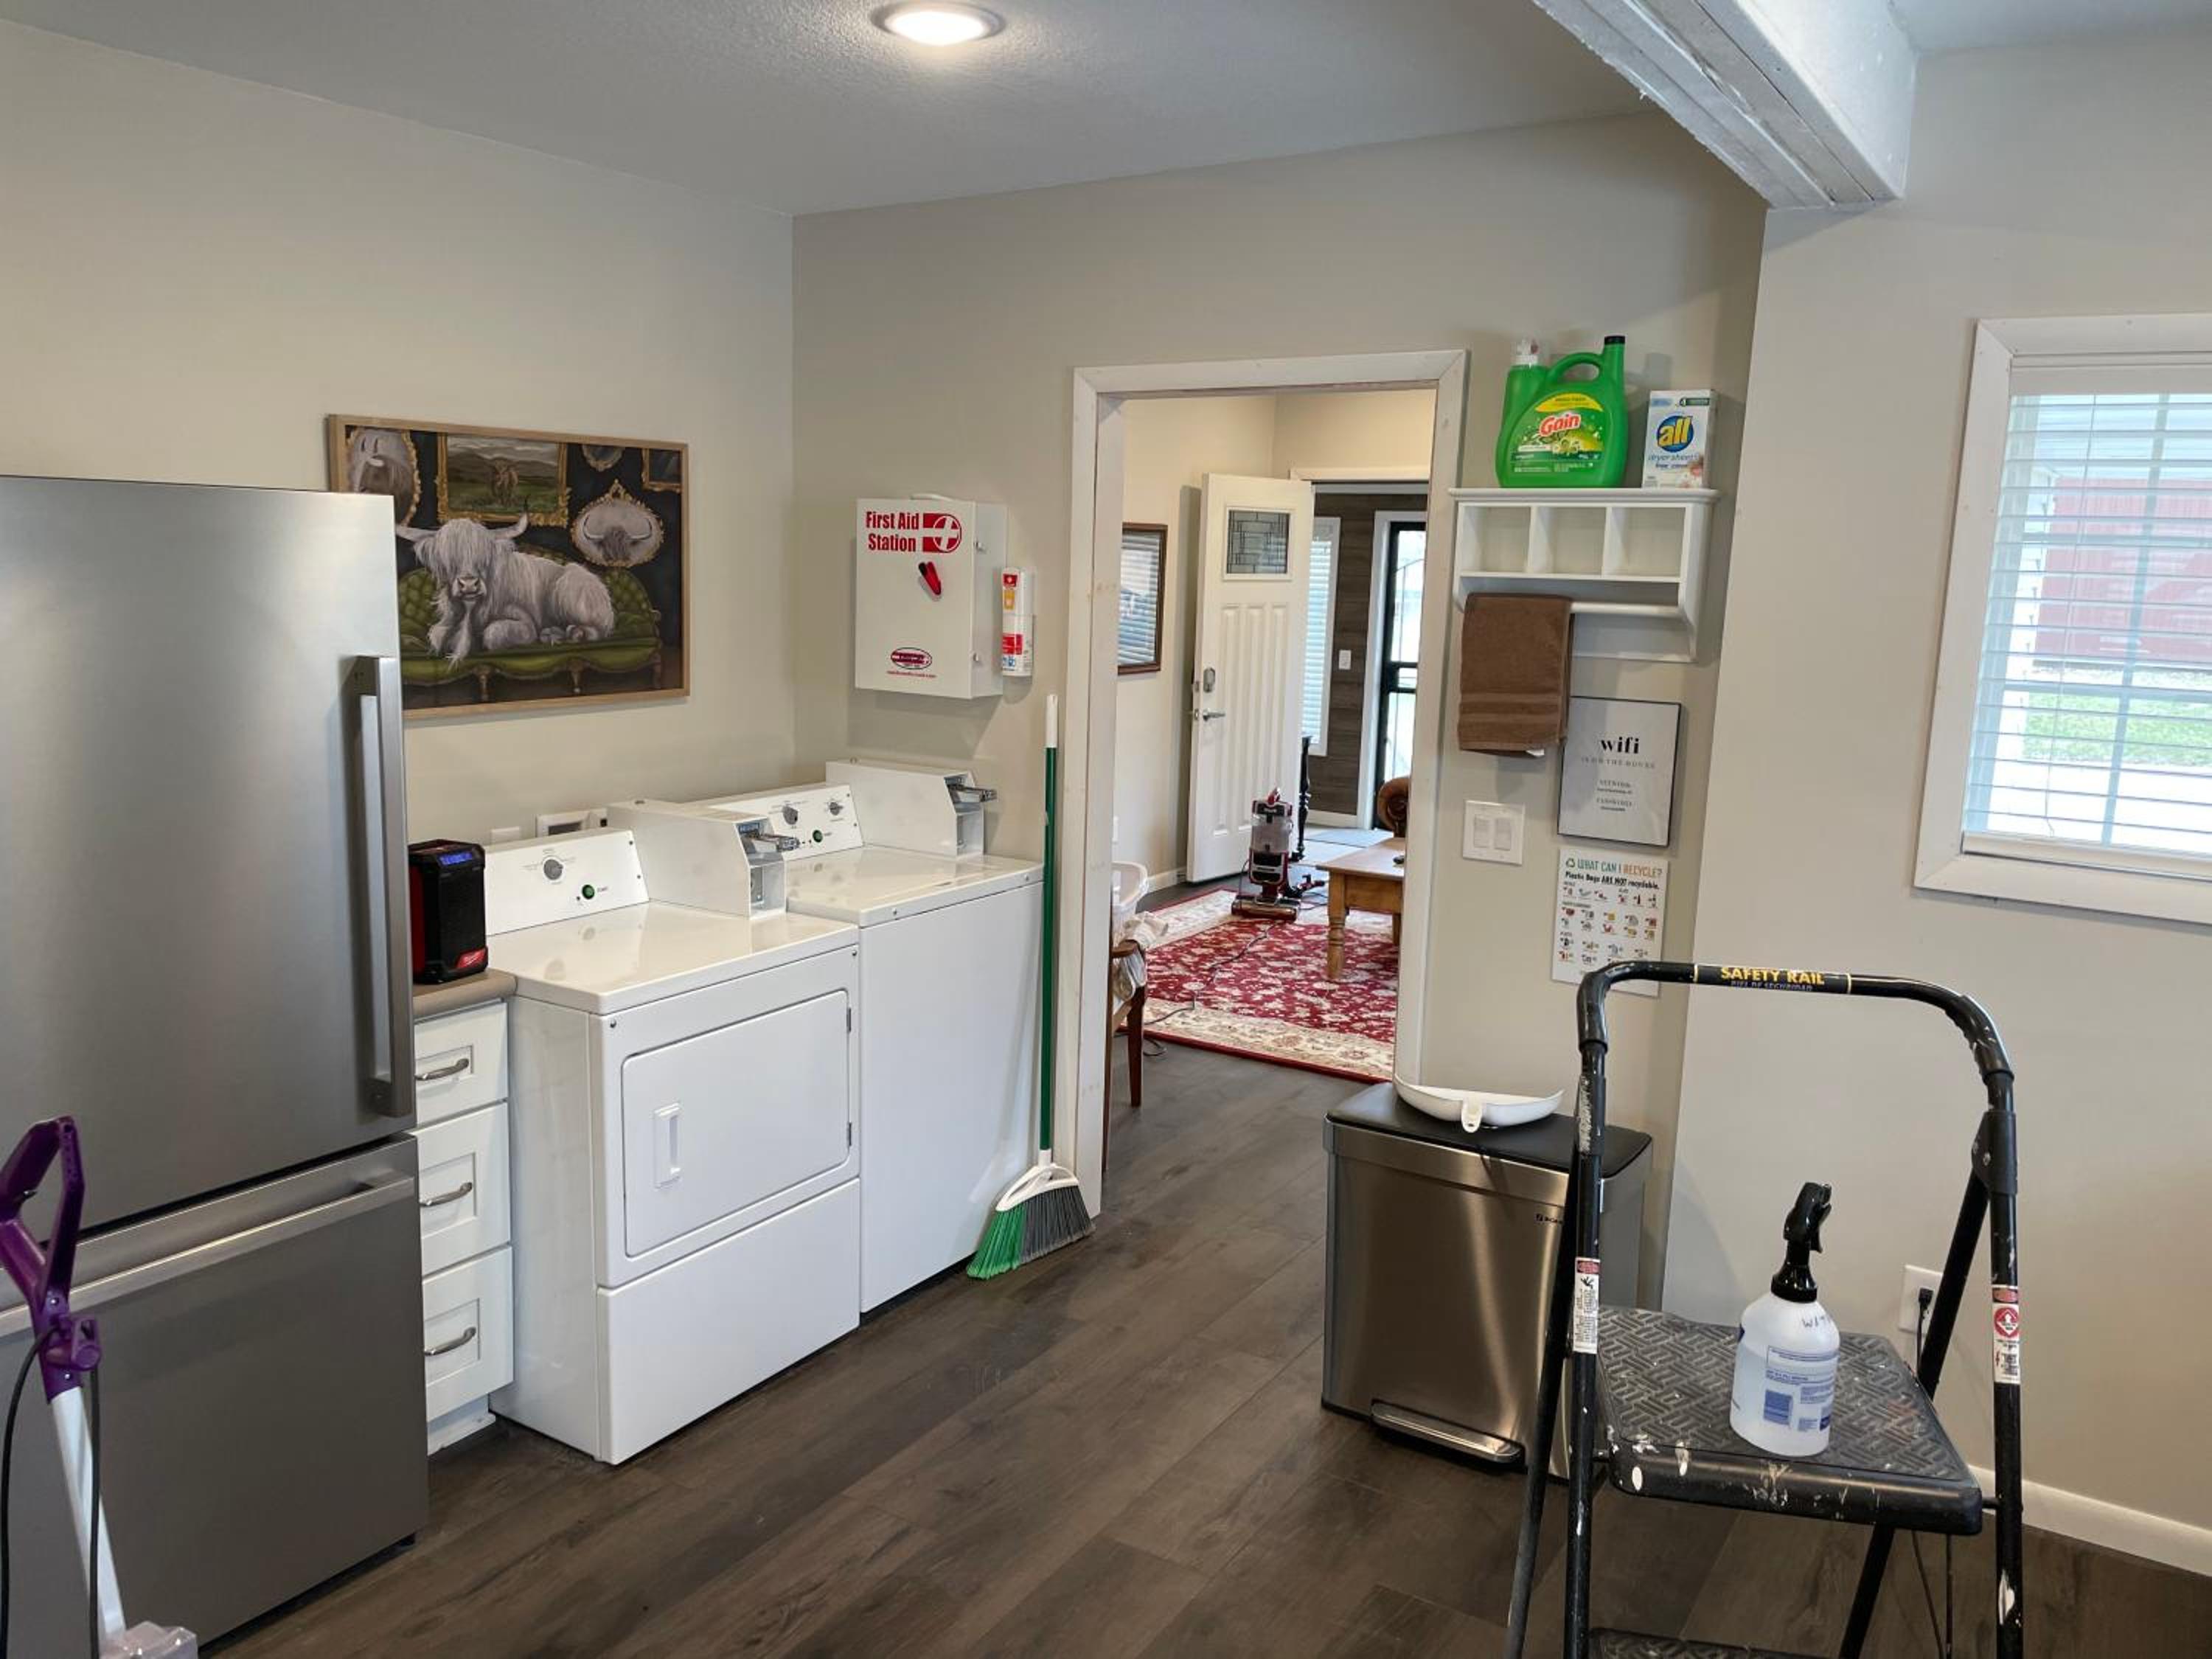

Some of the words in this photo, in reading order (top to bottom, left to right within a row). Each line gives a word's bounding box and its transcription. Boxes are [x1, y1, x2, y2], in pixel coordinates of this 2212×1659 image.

[1540, 413, 1582, 437] Gain
[1658, 416, 1693, 447] all
[866, 511, 895, 529] First
[898, 512, 919, 529] Aid
[868, 533, 917, 552] Station
[1600, 737, 1639, 754] wifi
[1577, 858, 1599, 870] WHAT
[1601, 860, 1617, 873] CAN
[1721, 967, 1780, 981] SAFETY
[1787, 969, 1825, 985] RAIL
